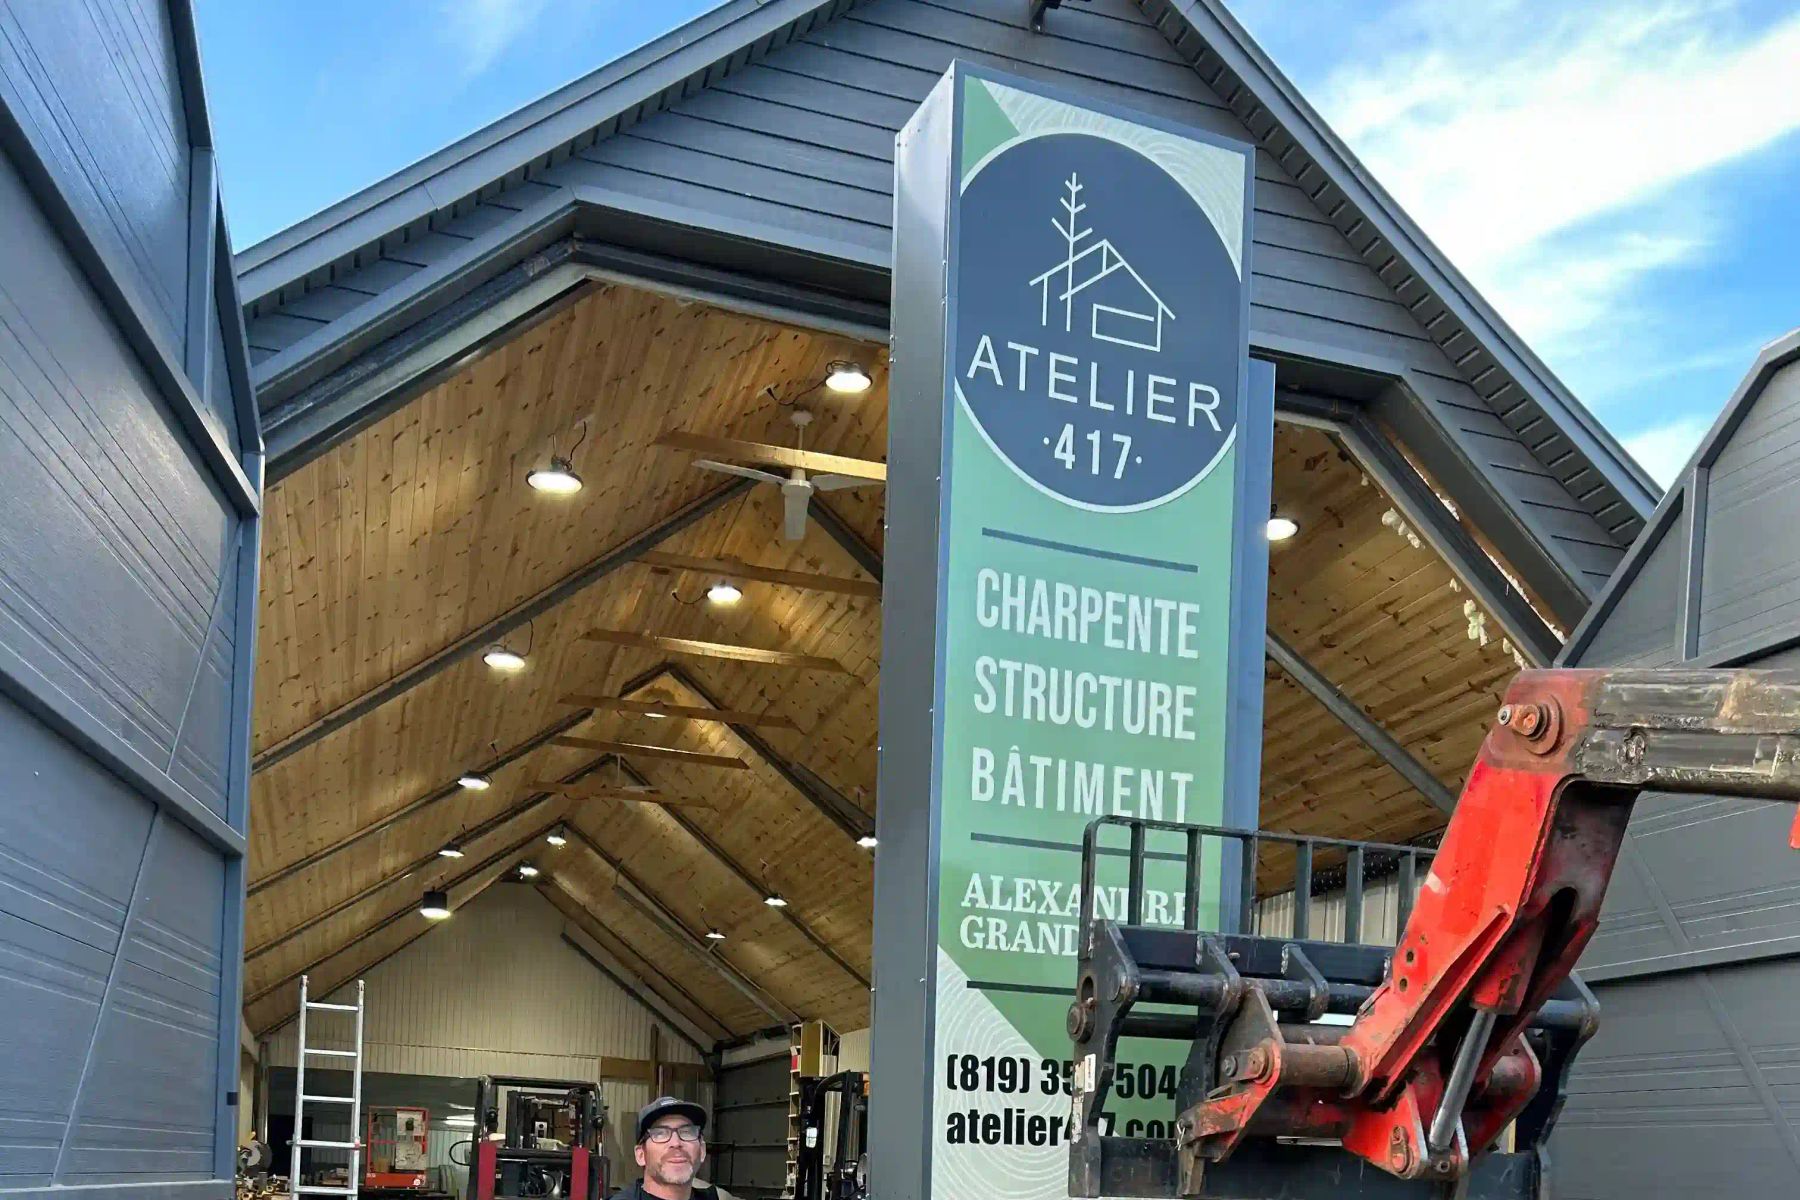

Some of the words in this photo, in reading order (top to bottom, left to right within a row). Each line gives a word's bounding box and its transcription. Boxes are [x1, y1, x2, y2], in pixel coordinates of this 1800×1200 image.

[966, 334, 1222, 432] ATELIER
[976, 568, 1199, 659] CHARPENTE
[974, 655, 1197, 740] STRUCTURE
[971, 745, 1194, 823] BÂTIMENT
[947, 1054, 1031, 1094] (819)
